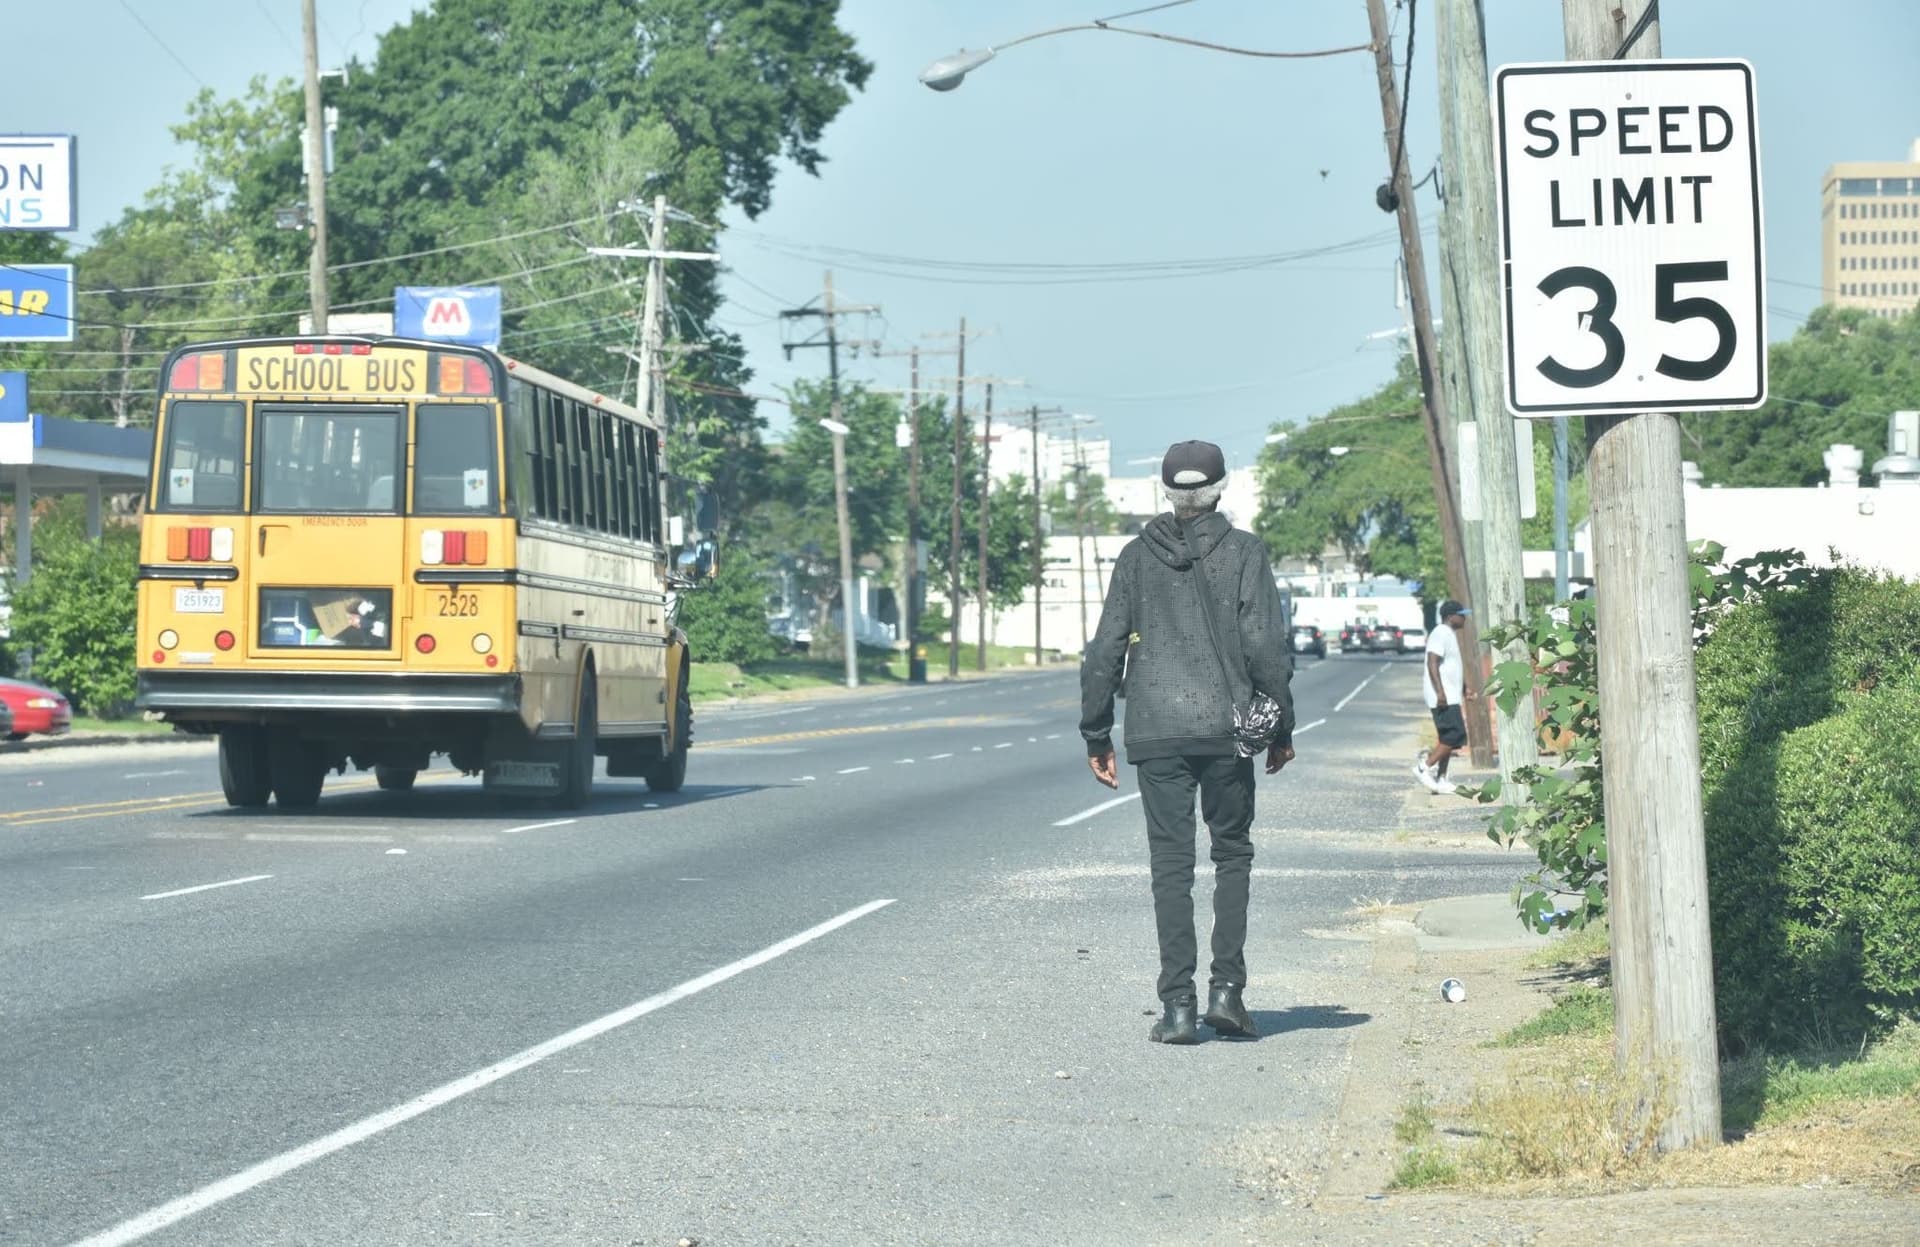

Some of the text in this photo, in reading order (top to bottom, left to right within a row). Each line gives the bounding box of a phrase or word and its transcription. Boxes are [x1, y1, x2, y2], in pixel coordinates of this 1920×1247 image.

[1523, 105, 1734, 159] SPEED
[1550, 175, 1713, 228] LIMIT
[431, 302, 462, 324] M
[1536, 260, 1738, 389] 35
[248, 356, 416, 392] SCHOOL BUS
[438, 594, 479, 617] 2528
